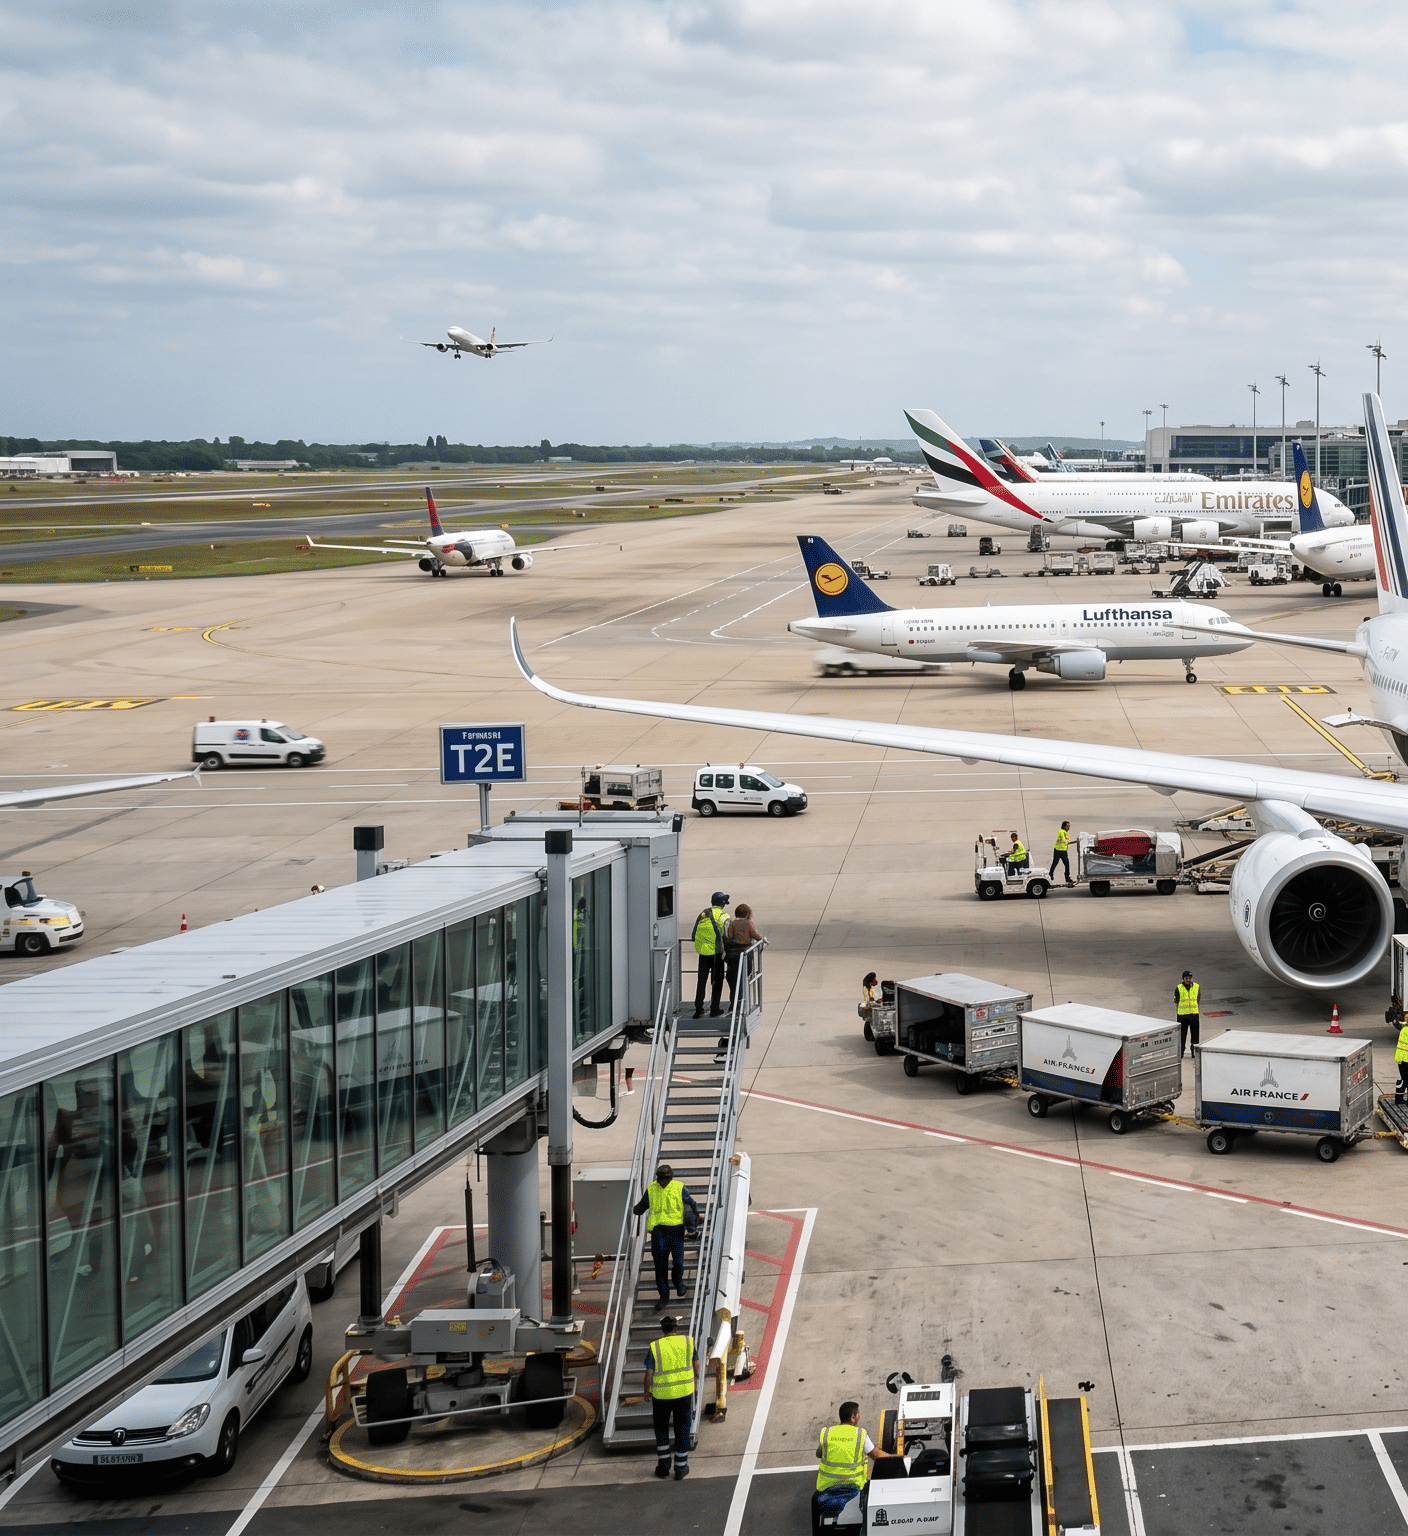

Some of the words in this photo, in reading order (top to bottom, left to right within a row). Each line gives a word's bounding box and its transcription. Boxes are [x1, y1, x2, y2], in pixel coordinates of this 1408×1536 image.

[1200, 491, 1294, 510] Emirates
[1083, 608, 1173, 621] Lufthansa
[450, 743, 515, 773] T2E
[1230, 1088, 1251, 1097] AIR
[1253, 1090, 1299, 1101] FRANCE
